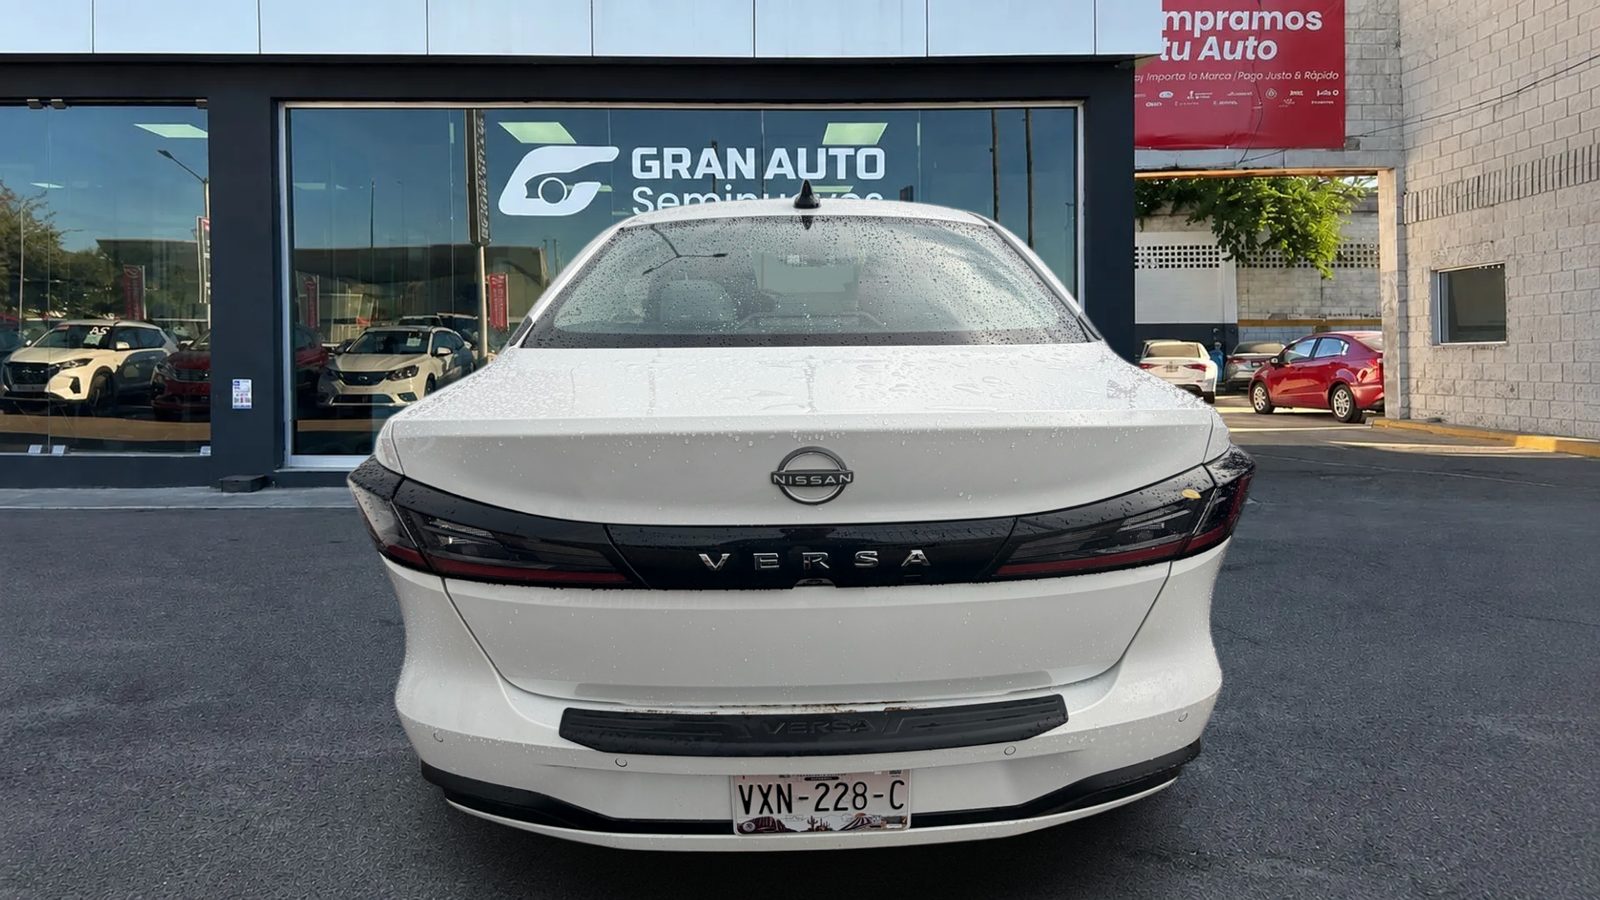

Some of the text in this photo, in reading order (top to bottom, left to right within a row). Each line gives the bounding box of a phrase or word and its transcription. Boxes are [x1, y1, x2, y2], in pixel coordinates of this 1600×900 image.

[1160, 36, 1277, 61] tu Auto
[1146, 72, 1186, 83] Importa
[1199, 71, 1232, 81] Marca
[632, 147, 885, 180] GRAN AUTO
[773, 473, 851, 485] NISSAN
[698, 550, 931, 571] VERSA
[762, 719, 876, 734] VERSA
[738, 780, 905, 815] VXN-228-C
